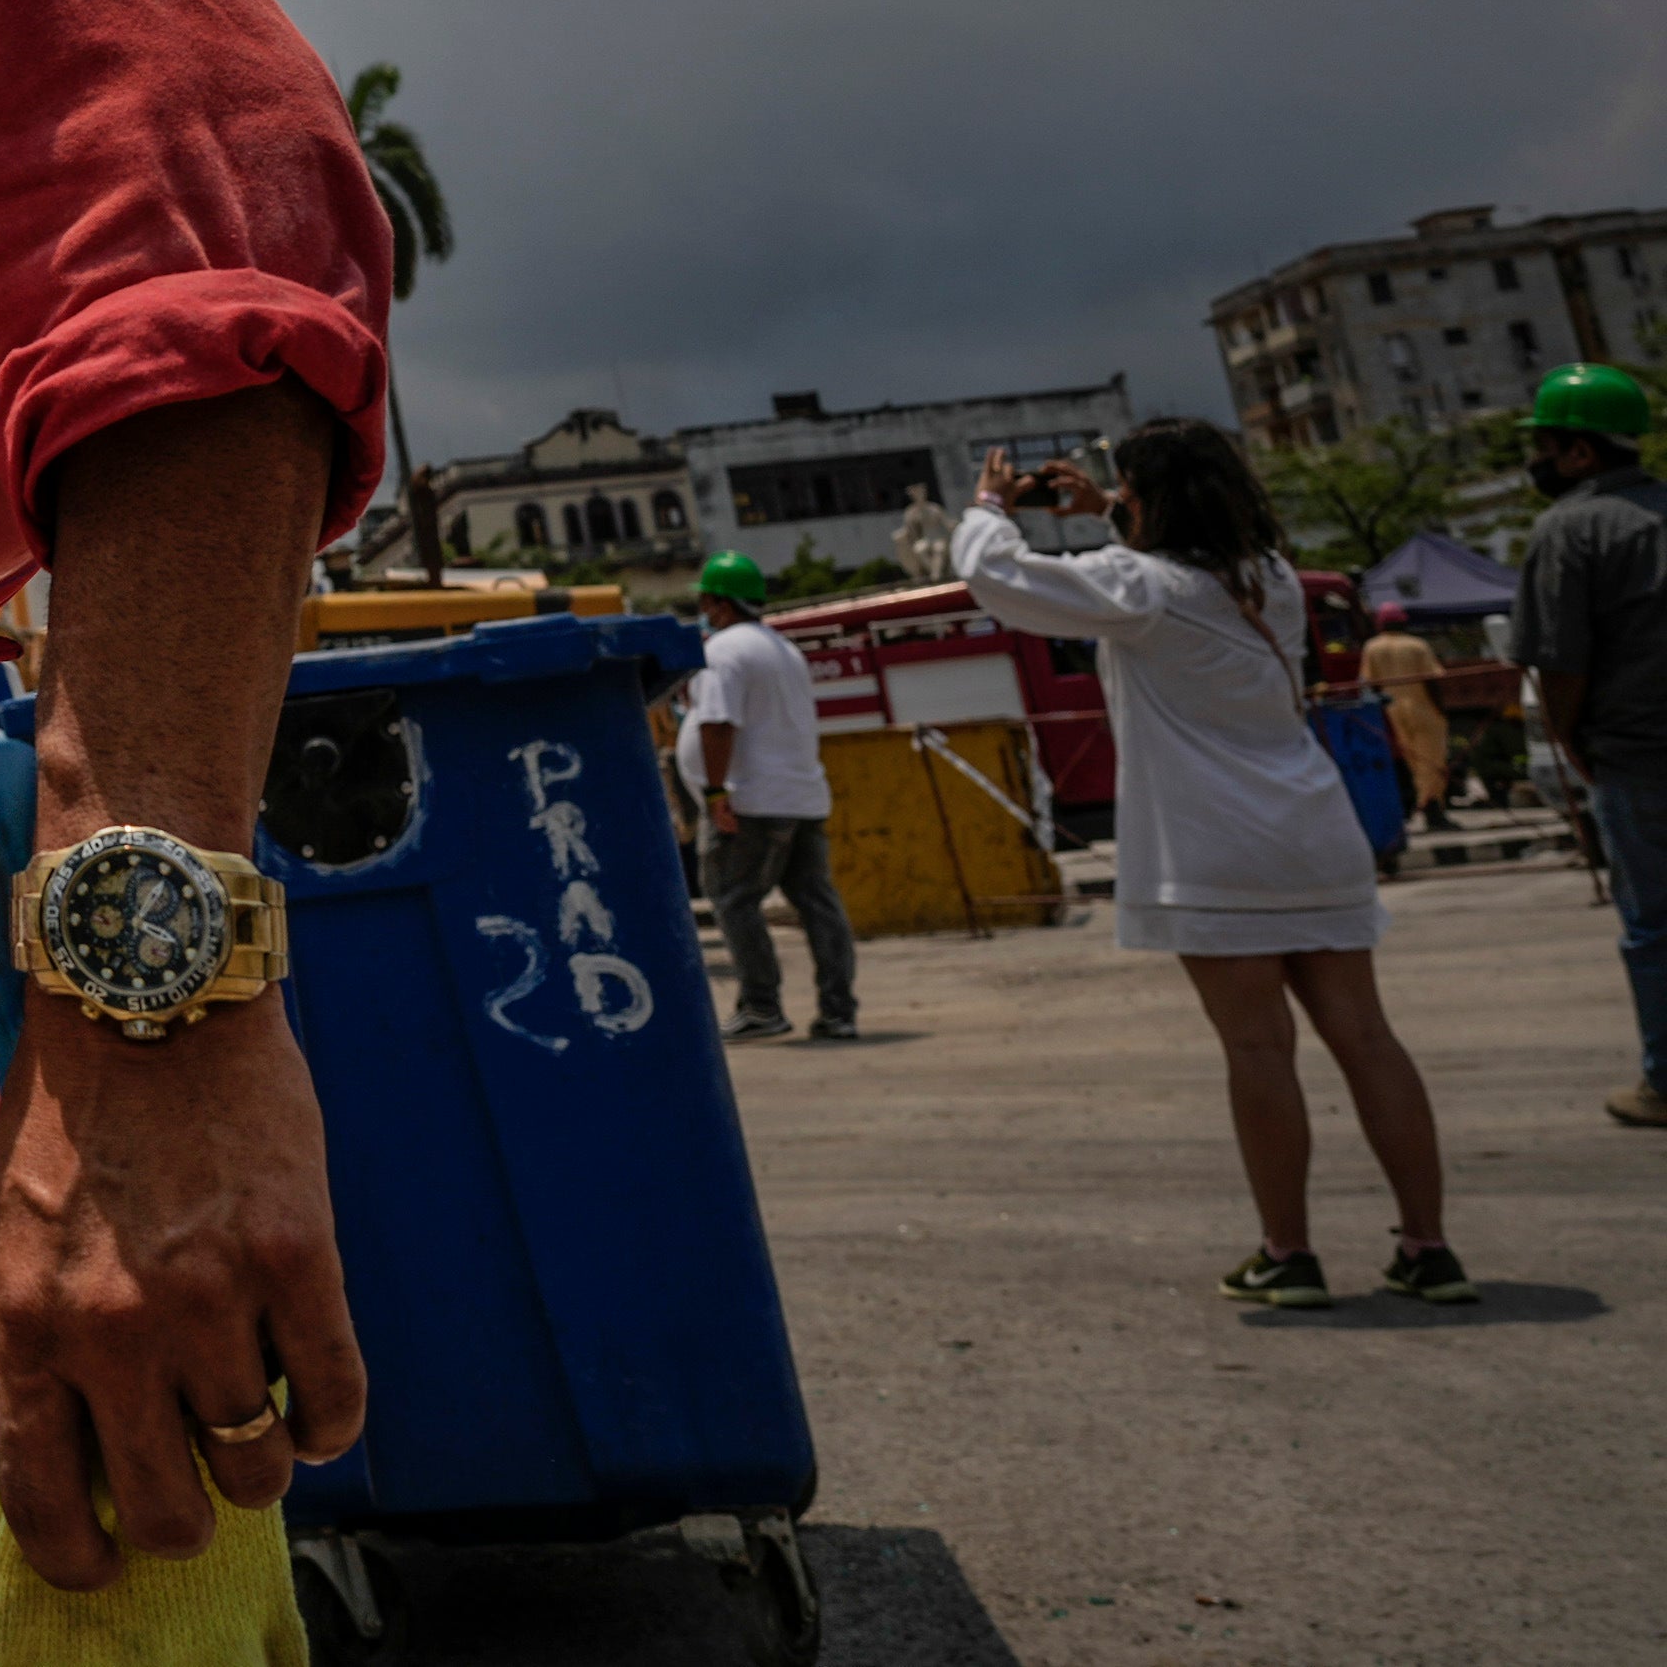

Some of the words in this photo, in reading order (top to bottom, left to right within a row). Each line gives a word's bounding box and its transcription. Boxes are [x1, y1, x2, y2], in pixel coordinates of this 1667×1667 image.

[81, 839, 104, 859] 40
[119, 832, 145, 846] 45
[45, 906, 60, 931] 30
[53, 946, 75, 973] 25
[83, 980, 109, 1004] 20
